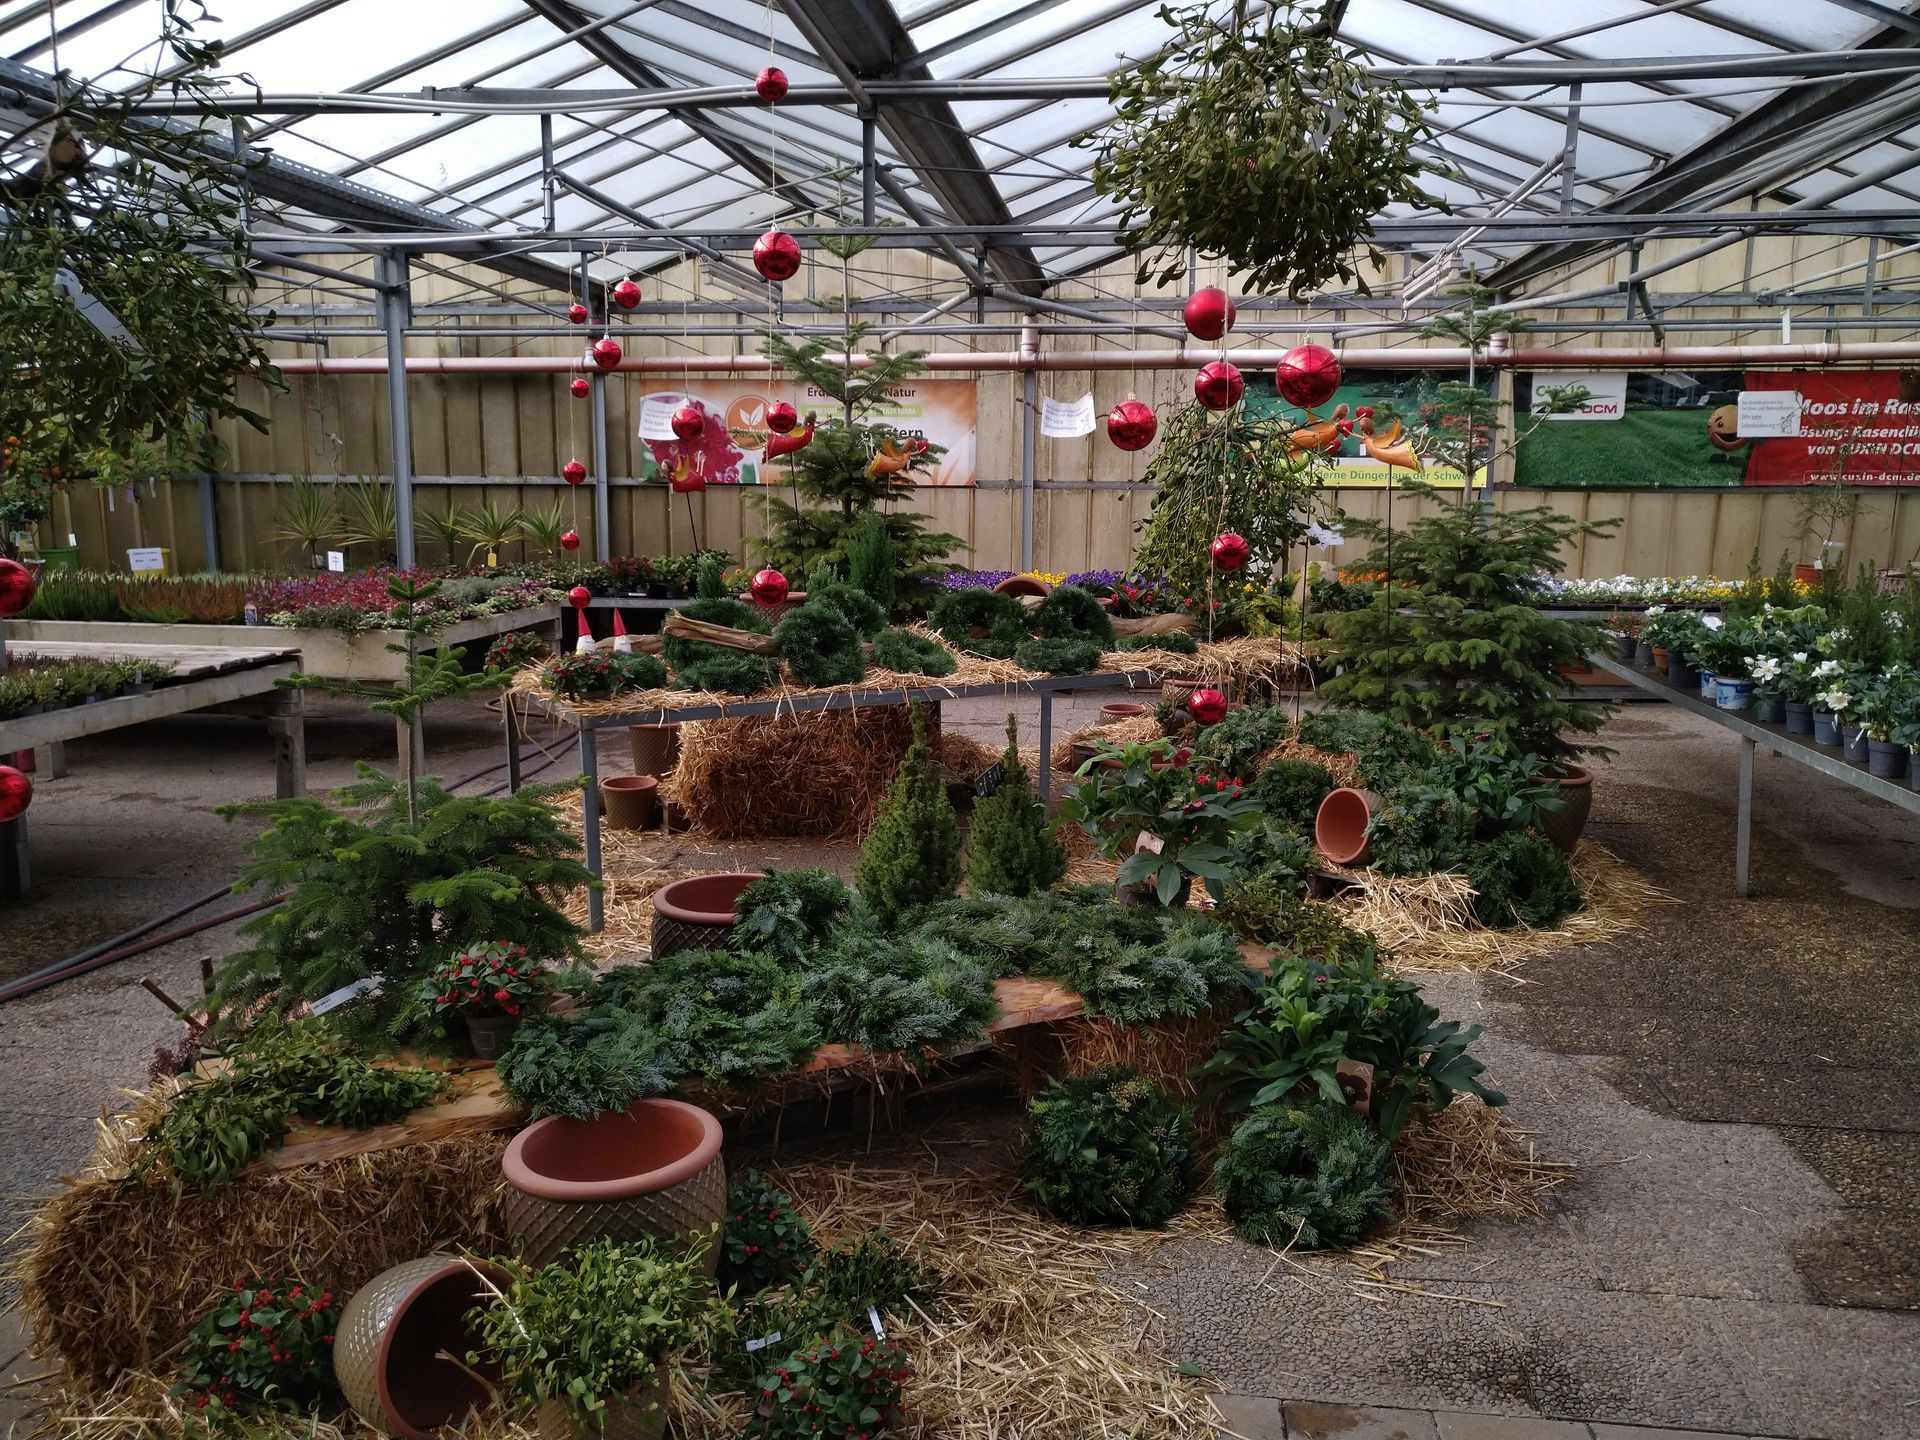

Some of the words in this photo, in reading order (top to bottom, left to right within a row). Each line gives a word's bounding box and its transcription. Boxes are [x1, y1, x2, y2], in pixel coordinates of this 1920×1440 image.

[884, 386, 917, 397] Natur
[1800, 426, 1849, 440] ösung:
[1808, 445, 1836, 455] von
[1297, 470, 1347, 480] Mderne
[1412, 471, 1431, 480] der
[1434, 471, 1478, 480] Schwez
